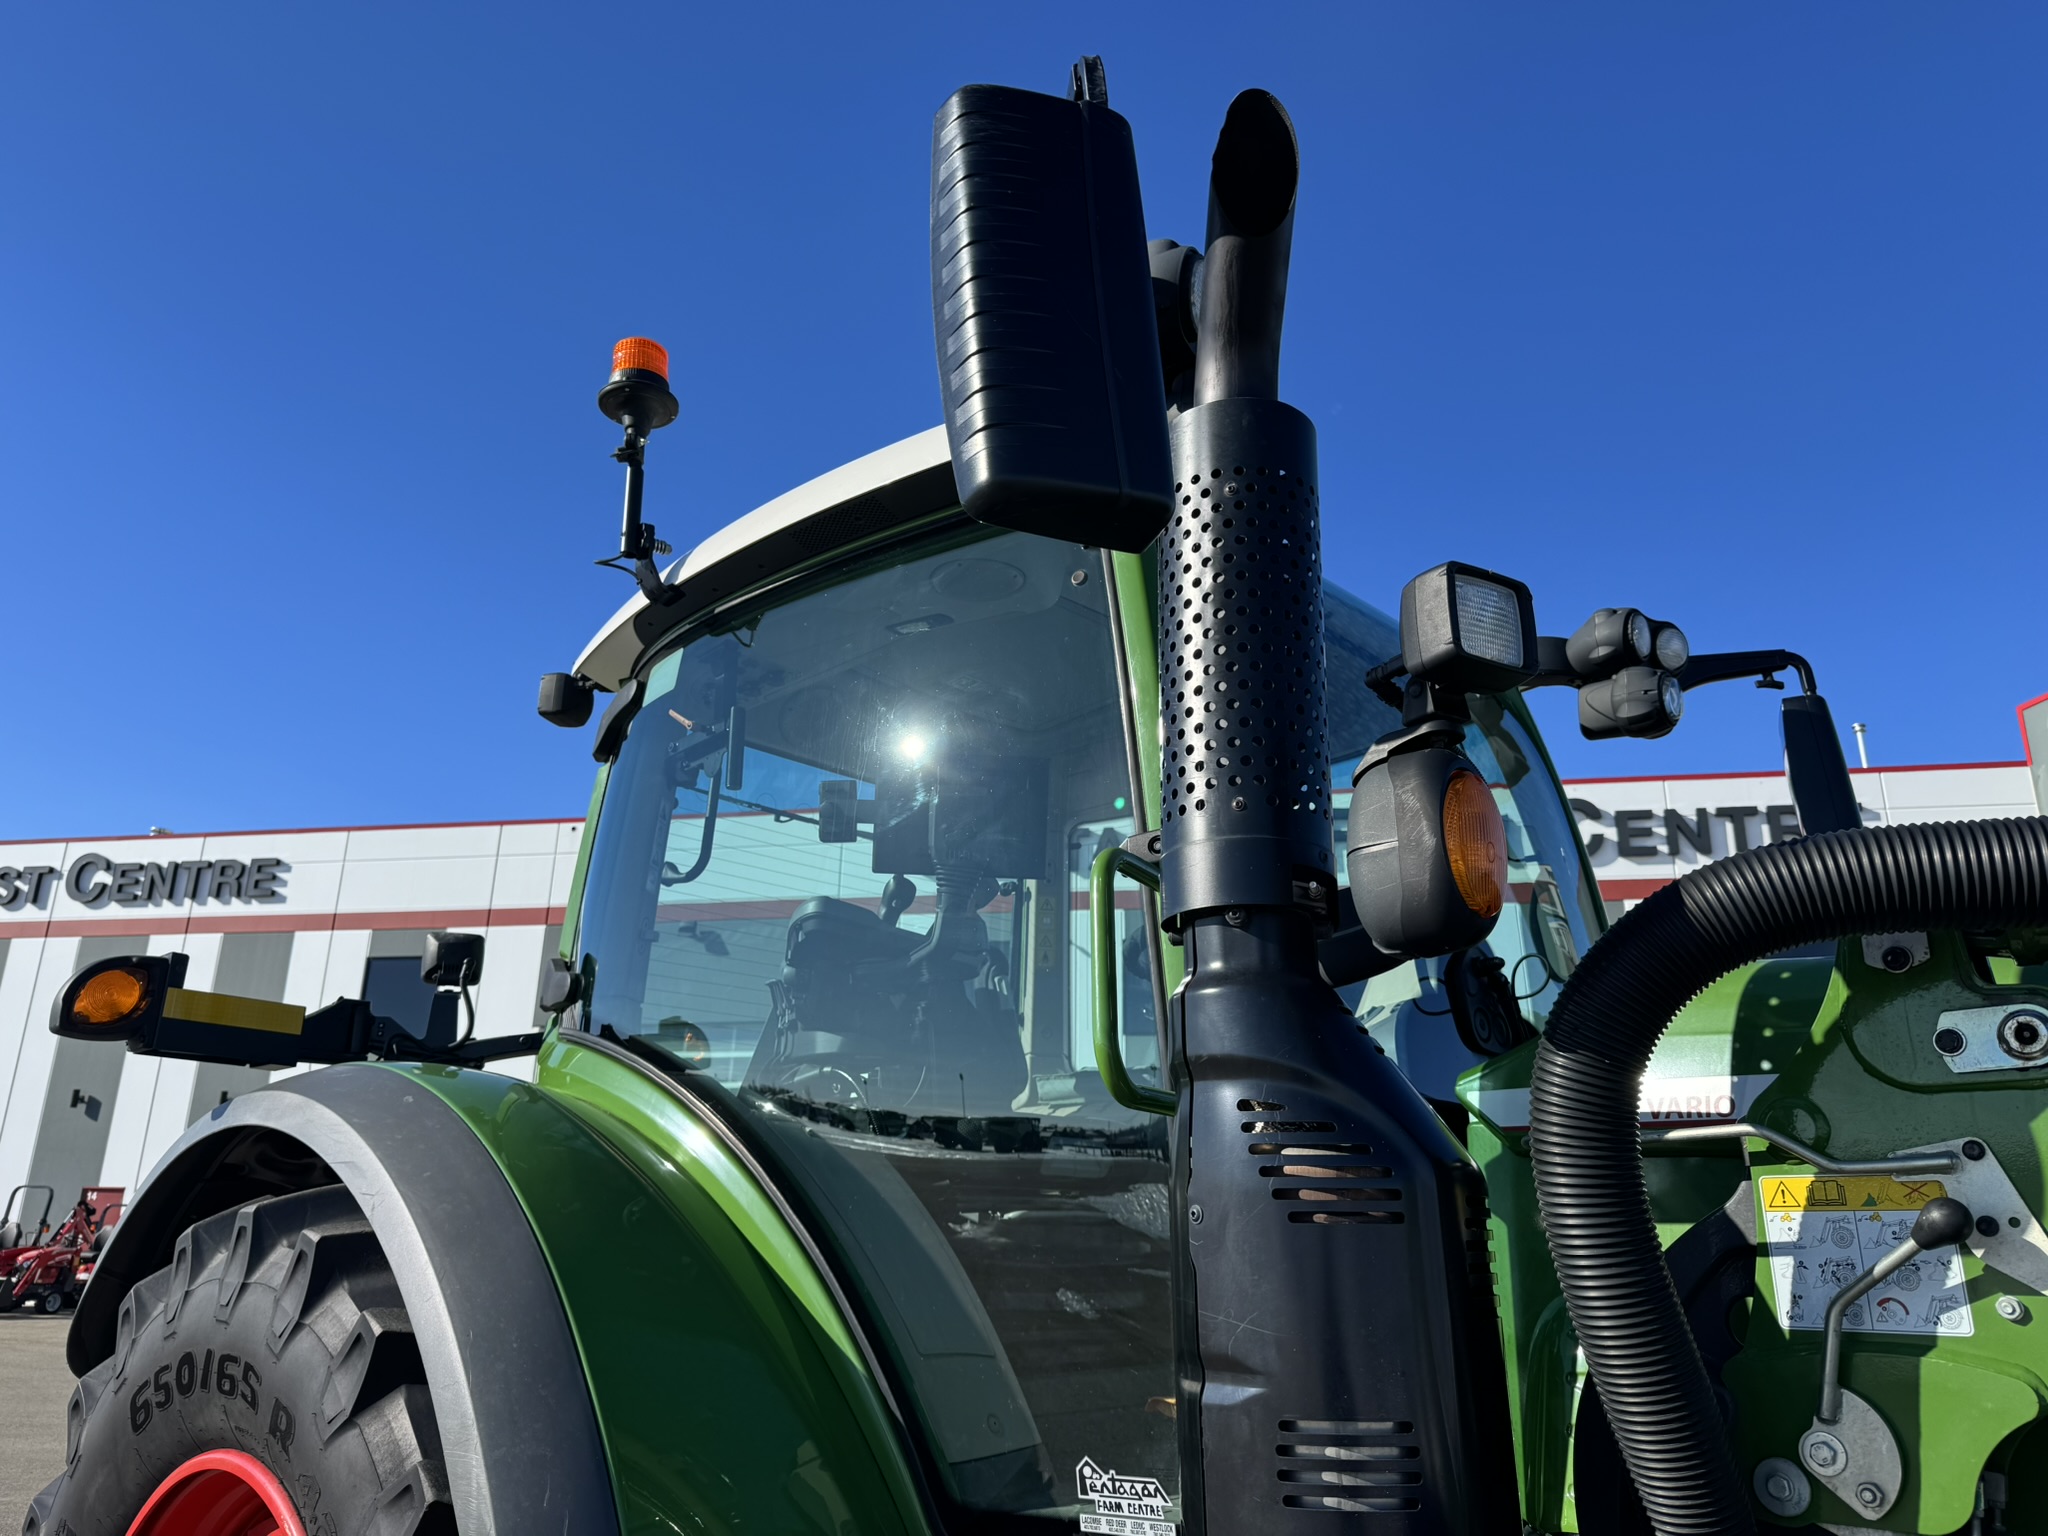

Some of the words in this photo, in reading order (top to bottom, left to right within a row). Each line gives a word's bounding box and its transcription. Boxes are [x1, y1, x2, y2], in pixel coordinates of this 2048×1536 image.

[65, 852, 284, 904] CENTRE
[1647, 1094, 1736, 1120] VARIO
[87, 1191, 98, 1201] 14
[1097, 1500, 1124, 1513] FARM
[1128, 1503, 1163, 1517] CENTRE
